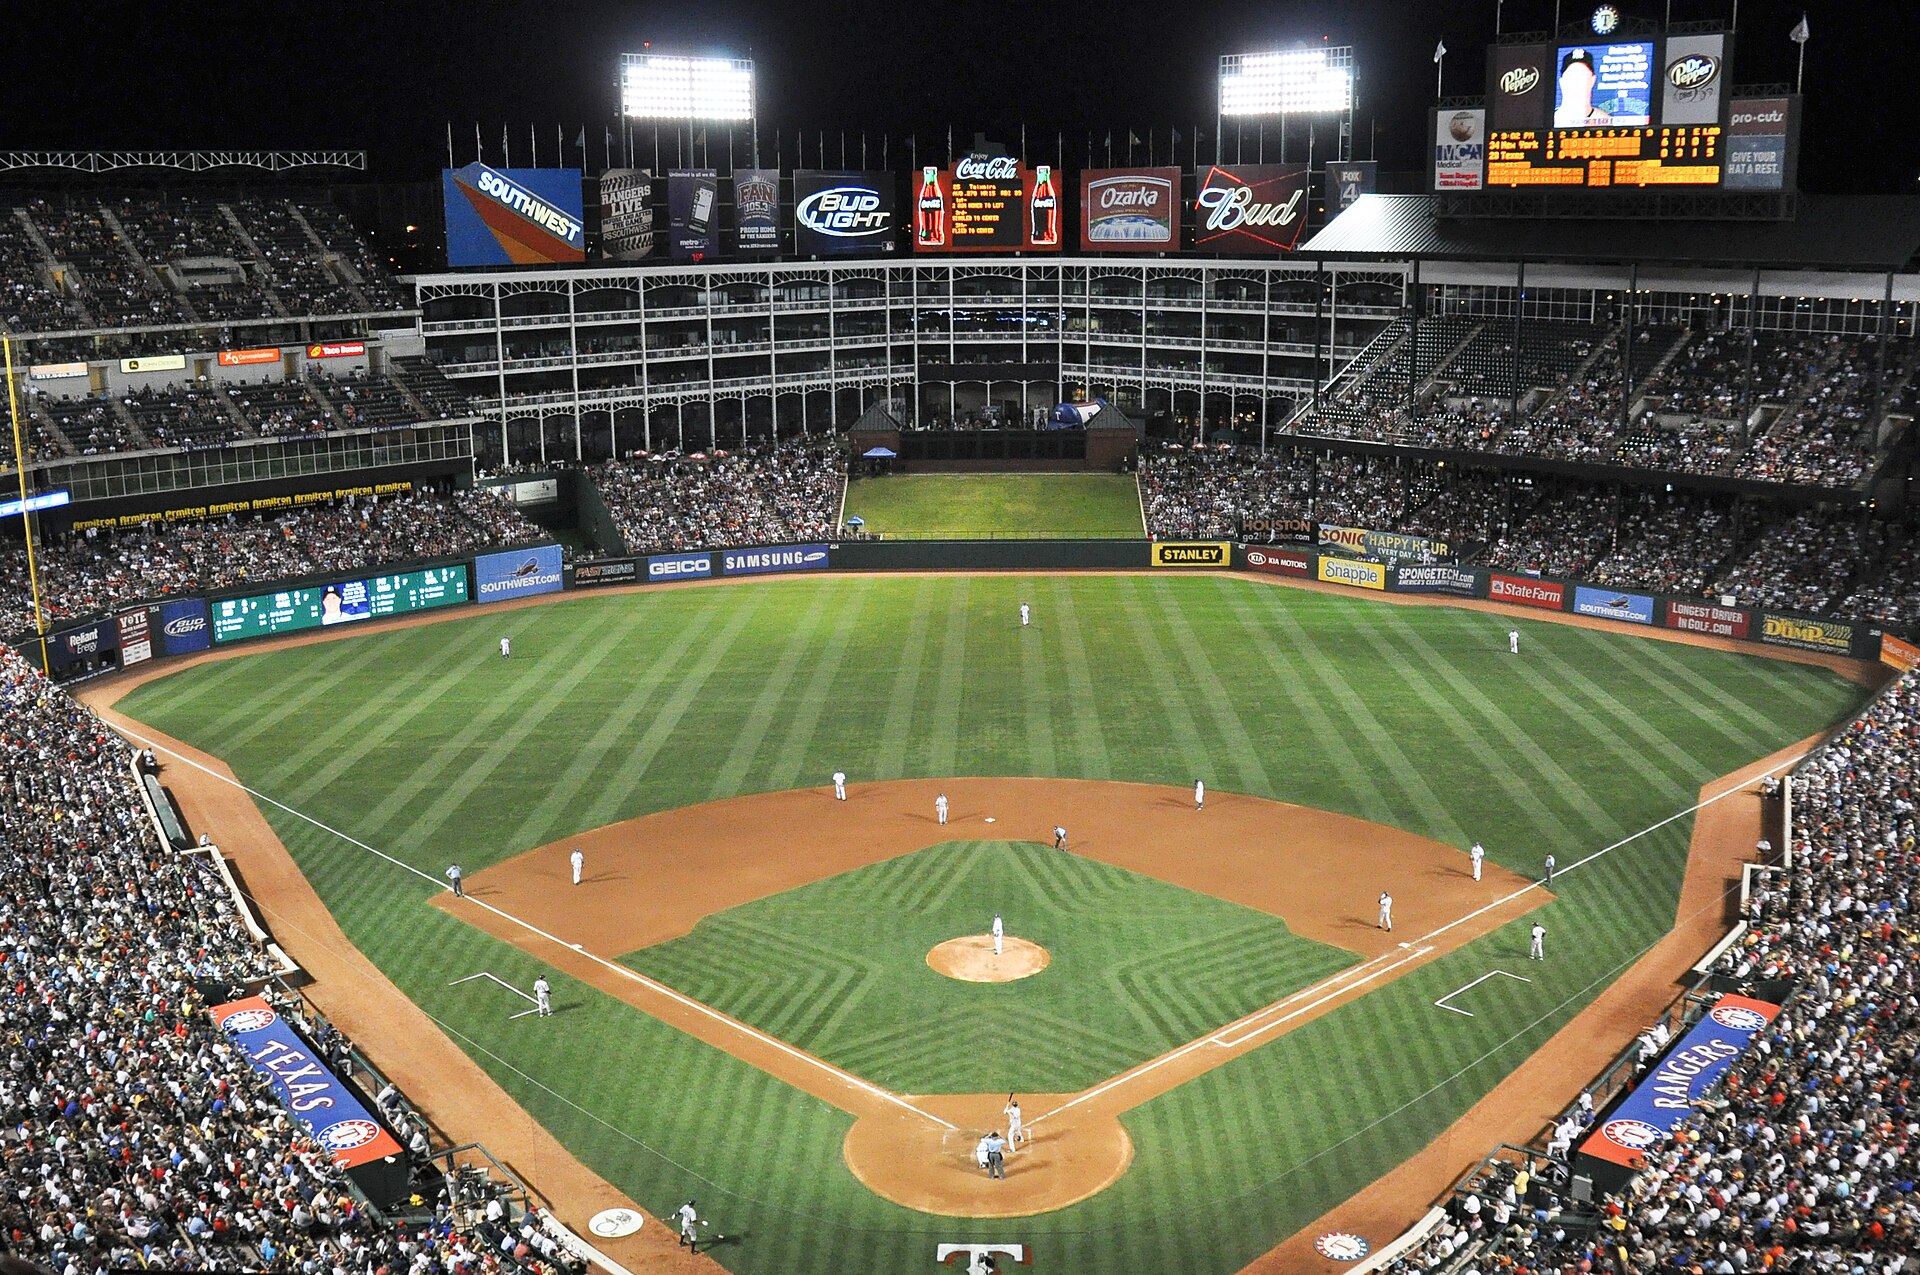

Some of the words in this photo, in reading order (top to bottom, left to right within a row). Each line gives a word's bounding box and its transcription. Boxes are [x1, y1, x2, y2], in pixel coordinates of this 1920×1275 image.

[1686, 59, 1703, 71] Dr
[1501, 71, 1536, 92] Pepper
[1514, 68, 1528, 80] Dr
[1671, 63, 1712, 85] Pepper
[1559, 131, 1567, 139] 2
[1571, 130, 1579, 138] 3
[1583, 130, 1591, 138] 4
[1595, 129, 1603, 138] 5
[1608, 129, 1615, 137] 6
[1620, 129, 1628, 137] 7
[1633, 129, 1641, 137] 8
[1646, 129, 1654, 137] 9
[1692, 127, 1701, 136] E
[1488, 140, 1500, 149] 34
[1518, 140, 1539, 149] York
[1546, 139, 1554, 149] 2
[1661, 137, 1669, 147] 6
[1675, 137, 1686, 147] 11
[1691, 136, 1699, 146] 0
[1706, 136, 1715, 146] 5
[1500, 151, 1525, 160] Texas
[1546, 150, 1554, 159] 0
[1558, 150, 1566, 159] 0
[1660, 148, 1668, 158] 0
[1675, 147, 1683, 158] 3
[1692, 147, 1697, 158] 1
[1706, 147, 1715, 158] 5
[1731, 152, 1751, 162] GIVE
[1752, 151, 1776, 162] YOUR
[1342, 172, 1360, 181] FOX
[1728, 164, 1745, 174] HAT
[1745, 164, 1753, 174] A
[601, 185, 651, 206] RANGERS
[740, 183, 775, 206] FAN
[1101, 186, 1158, 208] Ozarka
[1343, 183, 1358, 202] 4
[478, 171, 582, 242] SOUTHWEST
[611, 198, 643, 217] LIVE
[746, 202, 769, 212] 105.3
[818, 194, 880, 211] BUD
[1200, 185, 1303, 230] Bud
[612, 222, 624, 230] THE
[807, 211, 890, 228] LIGHT
[73, 516, 116, 529] Armitron
[120, 512, 162, 526] Armitron
[209, 501, 250, 515] Armitron
[253, 496, 292, 509] Armitron
[294, 491, 333, 504] Armitron
[336, 486, 373, 498] Armitron
[375, 482, 412, 495] Armitron
[1242, 520, 1311, 532] HOUSTON
[1321, 529, 1366, 547] SONIC
[1369, 535, 1409, 550] HAPPY
[1412, 541, 1448, 556] HUR
[726, 552, 803, 570] SAMSUNG
[1164, 549, 1218, 560] STANLEY
[1250, 555, 1264, 563] KIA
[1378, 547, 1398, 557] EVERY
[1400, 550, 1413, 558] DAY
[649, 559, 710, 575] GEICO
[1268, 557, 1280, 565] KIA
[1280, 559, 1308, 569] MOTORS
[1325, 561, 1378, 585] Snapple
[1398, 568, 1474, 583] SPONGETECH.com
[480, 574, 560, 593] SOUTHWEST.COM
[120, 611, 146, 628] VOTE
[1579, 603, 1647, 621] SOUTHWEST.COM
[1672, 602, 1710, 618] LONGEST
[1711, 608, 1743, 623] DRIVER
[171, 623, 207, 634] LIGHT
[176, 618, 204, 627] BUD
[69, 628, 98, 648] Reliant
[77, 641, 98, 654] Energy
[251, 1039, 335, 1112] TEXAS
[1654, 1039, 1739, 1110] RANGERS
